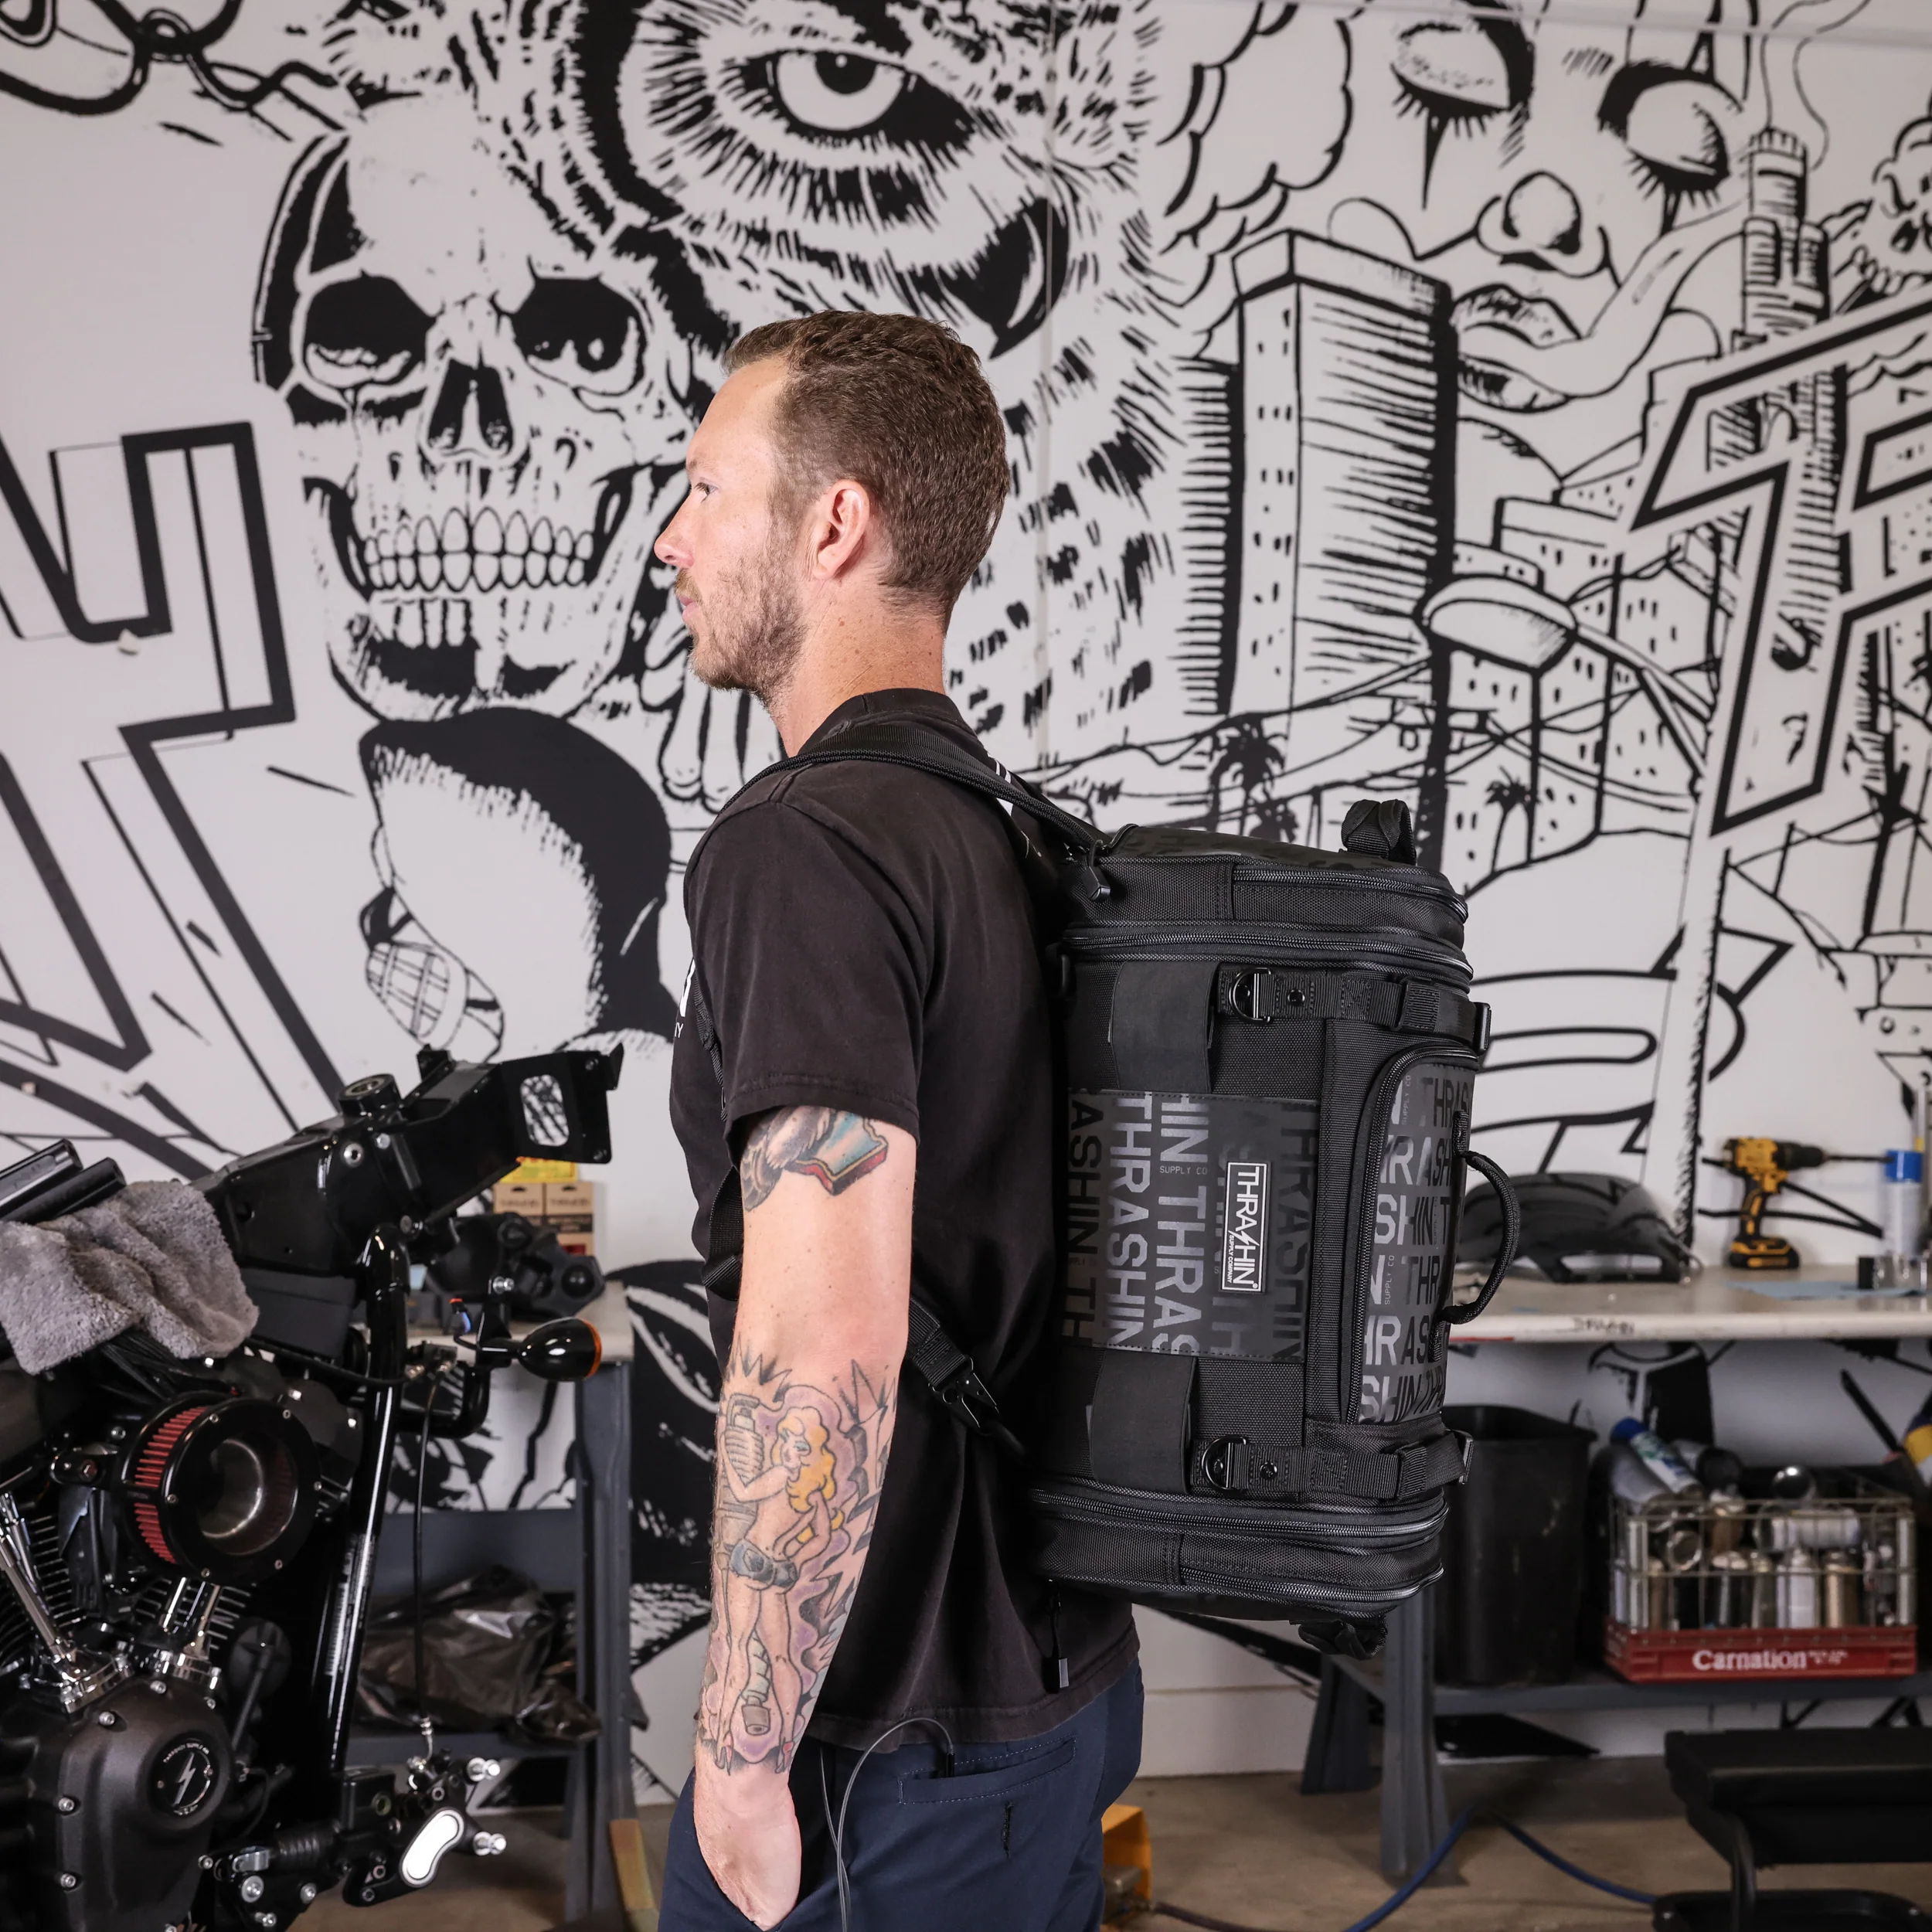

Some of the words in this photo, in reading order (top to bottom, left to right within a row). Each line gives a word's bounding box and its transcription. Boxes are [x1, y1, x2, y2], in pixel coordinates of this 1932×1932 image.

[1160, 1165, 1191, 1175] SUPPLY
[1107, 1091, 1152, 1351] THRASHIN
[1692, 1649, 1808, 1671] Carnation
